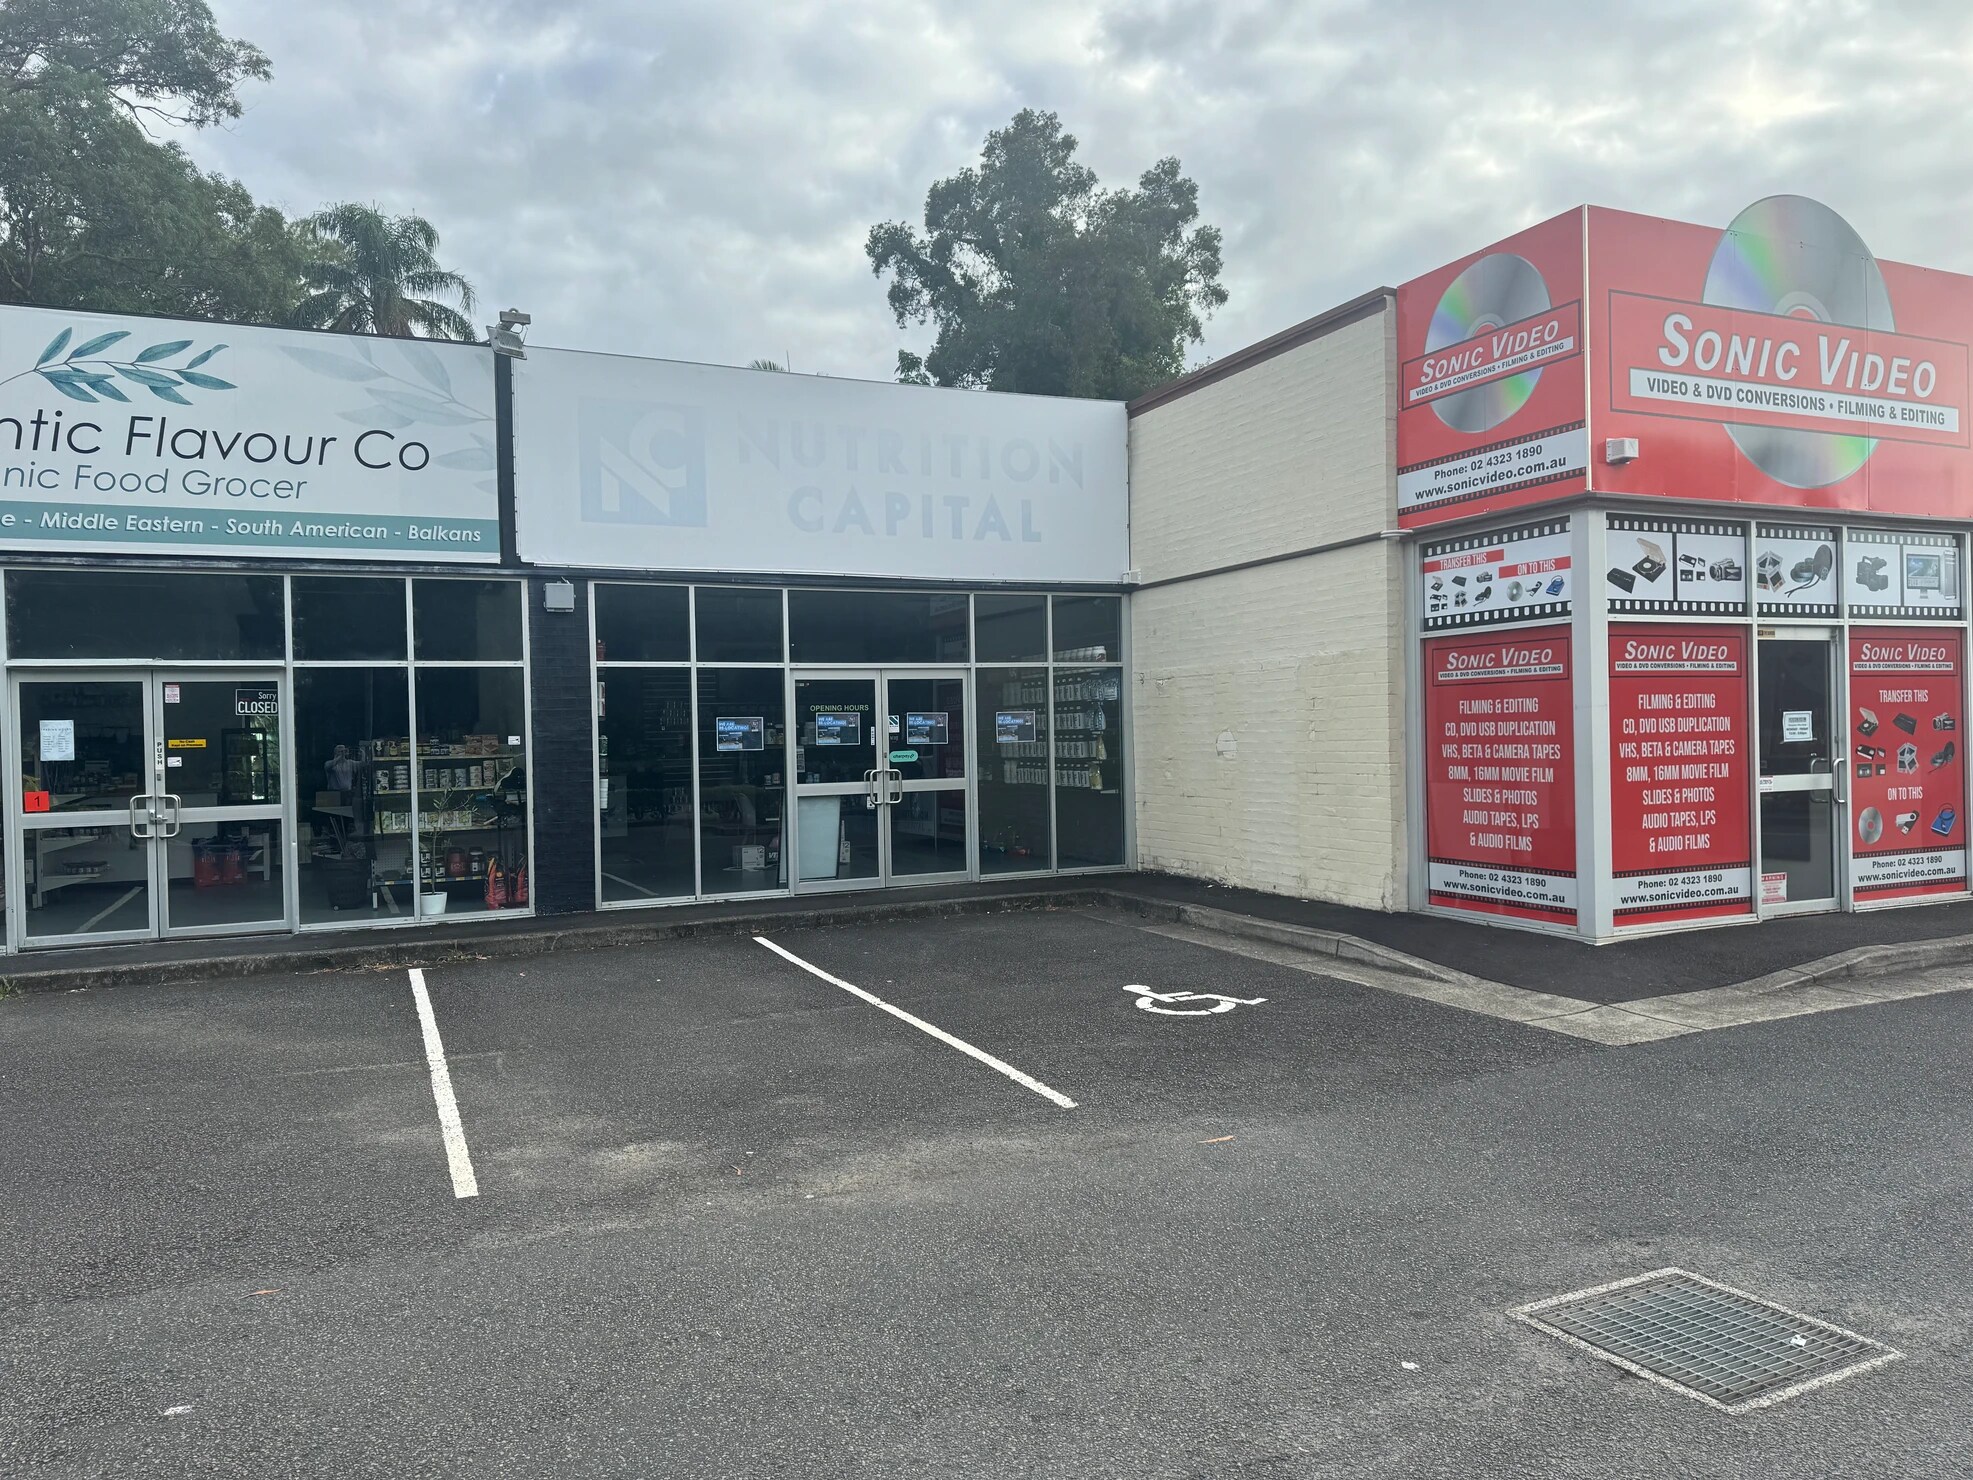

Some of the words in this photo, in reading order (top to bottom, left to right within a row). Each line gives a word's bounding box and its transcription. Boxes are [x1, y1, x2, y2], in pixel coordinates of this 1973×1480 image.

[1420, 346, 1484, 384] SONIC
[1492, 320, 1560, 359] VIDEO
[1658, 312, 1801, 382] SONIC
[1818, 334, 1936, 398] VIDEO
[1416, 386, 1434, 398] VIDEO
[1434, 384, 1439, 392] &
[1440, 378, 1452, 390] DVD
[1452, 364, 1496, 387] CONVERSIONS
[1502, 355, 1528, 370] FILMING
[1530, 352, 1535, 360] &
[1536, 341, 1564, 358] EDITING
[1646, 376, 1688, 396] VIDEO
[1692, 383, 1702, 397] &
[1706, 384, 1732, 401] DVD
[1736, 388, 1826, 412] CONVERSIONS
[1837, 399, 1886, 418] FILMING
[1889, 406, 1898, 420] &
[1900, 407, 1945, 426] EDITING
[125, 415, 338, 466] Flavour
[353, 429, 430, 471] Co
[736, 412, 1085, 490] NUTRITION
[1434, 465, 1468, 480] Phone:
[1470, 460, 1484, 472] 02
[1486, 452, 1512, 468] 4323
[1515, 444, 1543, 460] 1890
[3, 461, 60, 489] nic
[74, 464, 169, 493] Food
[181, 469, 307, 499] Grocer
[1414, 455, 1567, 500] www.sonicvideo.com.au
[785, 484, 1042, 543] CAPITAL
[40, 511, 118, 531] Middle
[124, 514, 204, 533] Eastern
[225, 518, 283, 536] South
[290, 520, 387, 540] American
[408, 524, 482, 542] Balkans
[1440, 555, 1472, 570] TRANSFER
[1472, 552, 1487, 564] THIS
[1517, 564, 1528, 575] ON
[1528, 562, 1538, 574] TO
[1539, 560, 1556, 572] THIS
[1446, 652, 1496, 670] SONIC
[1501, 648, 1552, 666] VIDEO
[1624, 640, 1676, 660] SONIC
[1682, 641, 1728, 660] VIDEO
[1861, 643, 1902, 660] SONIC
[1908, 644, 1946, 660] VIDEO
[258, 692, 276, 702] Sorry
[1638, 694, 1673, 710] FILMING
[1675, 694, 1681, 709] &
[1683, 693, 1716, 709] EDITING
[1879, 690, 1912, 703] TRANSFER
[1914, 689, 1928, 702] THIS
[238, 701, 278, 714] CLOSED
[1460, 699, 1493, 714] FILMING
[1496, 699, 1502, 714] &
[1504, 698, 1539, 713] EDITING
[1444, 722, 1459, 739] CD,
[1460, 722, 1478, 737] DVD
[1478, 722, 1496, 736] USB
[1498, 720, 1556, 736] DUPLICATION
[1622, 718, 1638, 736] CD,
[1639, 718, 1657, 734] DVD
[1658, 718, 1676, 733] USB
[1678, 716, 1731, 733] DUPLICATION
[1442, 744, 1460, 760] VHS,
[1462, 744, 1483, 758] BETA
[1484, 744, 1491, 758] &
[1492, 744, 1530, 760] CAMERA
[1532, 744, 1561, 760] TAPES
[1619, 742, 1640, 760] VHS,
[1642, 742, 1664, 758] BETA
[1665, 741, 1670, 757] &
[1672, 740, 1708, 756] CAMERA
[1709, 740, 1735, 755] TAPES
[1474, 766, 1500, 781] 16MM
[1502, 767, 1530, 782] MOVIE
[1532, 768, 1554, 783] FILM
[1654, 765, 1680, 781] 16MM
[1682, 764, 1708, 780] MOVIE
[1710, 763, 1729, 778] FILM
[34, 796, 40, 806] 1
[1463, 788, 1492, 804] SLIDES
[1494, 789, 1500, 804] &
[1502, 790, 1538, 806] PHOTOS
[1642, 788, 1672, 806] SLIDES
[1674, 788, 1680, 804] &
[1682, 786, 1715, 803] PHOTOS
[1888, 788, 1897, 800] ON
[1898, 787, 1906, 800] TO
[1908, 786, 1924, 800] THIS
[1463, 810, 1488, 825] AUDIO
[1490, 811, 1520, 829] TAPES,
[1522, 814, 1539, 829] LPS
[1642, 812, 1668, 830] AUDIO
[1670, 811, 1698, 828] TAPES,
[1700, 810, 1716, 826] LPS
[1470, 832, 1476, 846] &
[1478, 832, 1504, 849] AUDIO
[1506, 834, 1532, 852] FILMS
[1650, 836, 1656, 852] &
[1658, 836, 1683, 852] AUDIO
[1685, 834, 1710, 850] FILMS
[1872, 860, 1896, 868] Phone:
[1897, 858, 1906, 867] 02
[1908, 856, 1925, 866] 4323
[1926, 855, 1942, 864] 1890
[1458, 869, 1487, 882] Phone:
[1488, 872, 1499, 882] 02
[1501, 874, 1522, 885] 4323
[1525, 876, 1546, 888] 1890
[1638, 880, 1666, 890] Phone:
[1668, 878, 1678, 886] 02
[1680, 876, 1701, 886] 4323
[1704, 874, 1723, 884] 1890
[1858, 866, 1956, 882] www.sonicvideo.com.au
[1443, 880, 1566, 904] www.sonicvideo.com.au
[1620, 886, 1739, 904] www.sonicvideo.com.au
